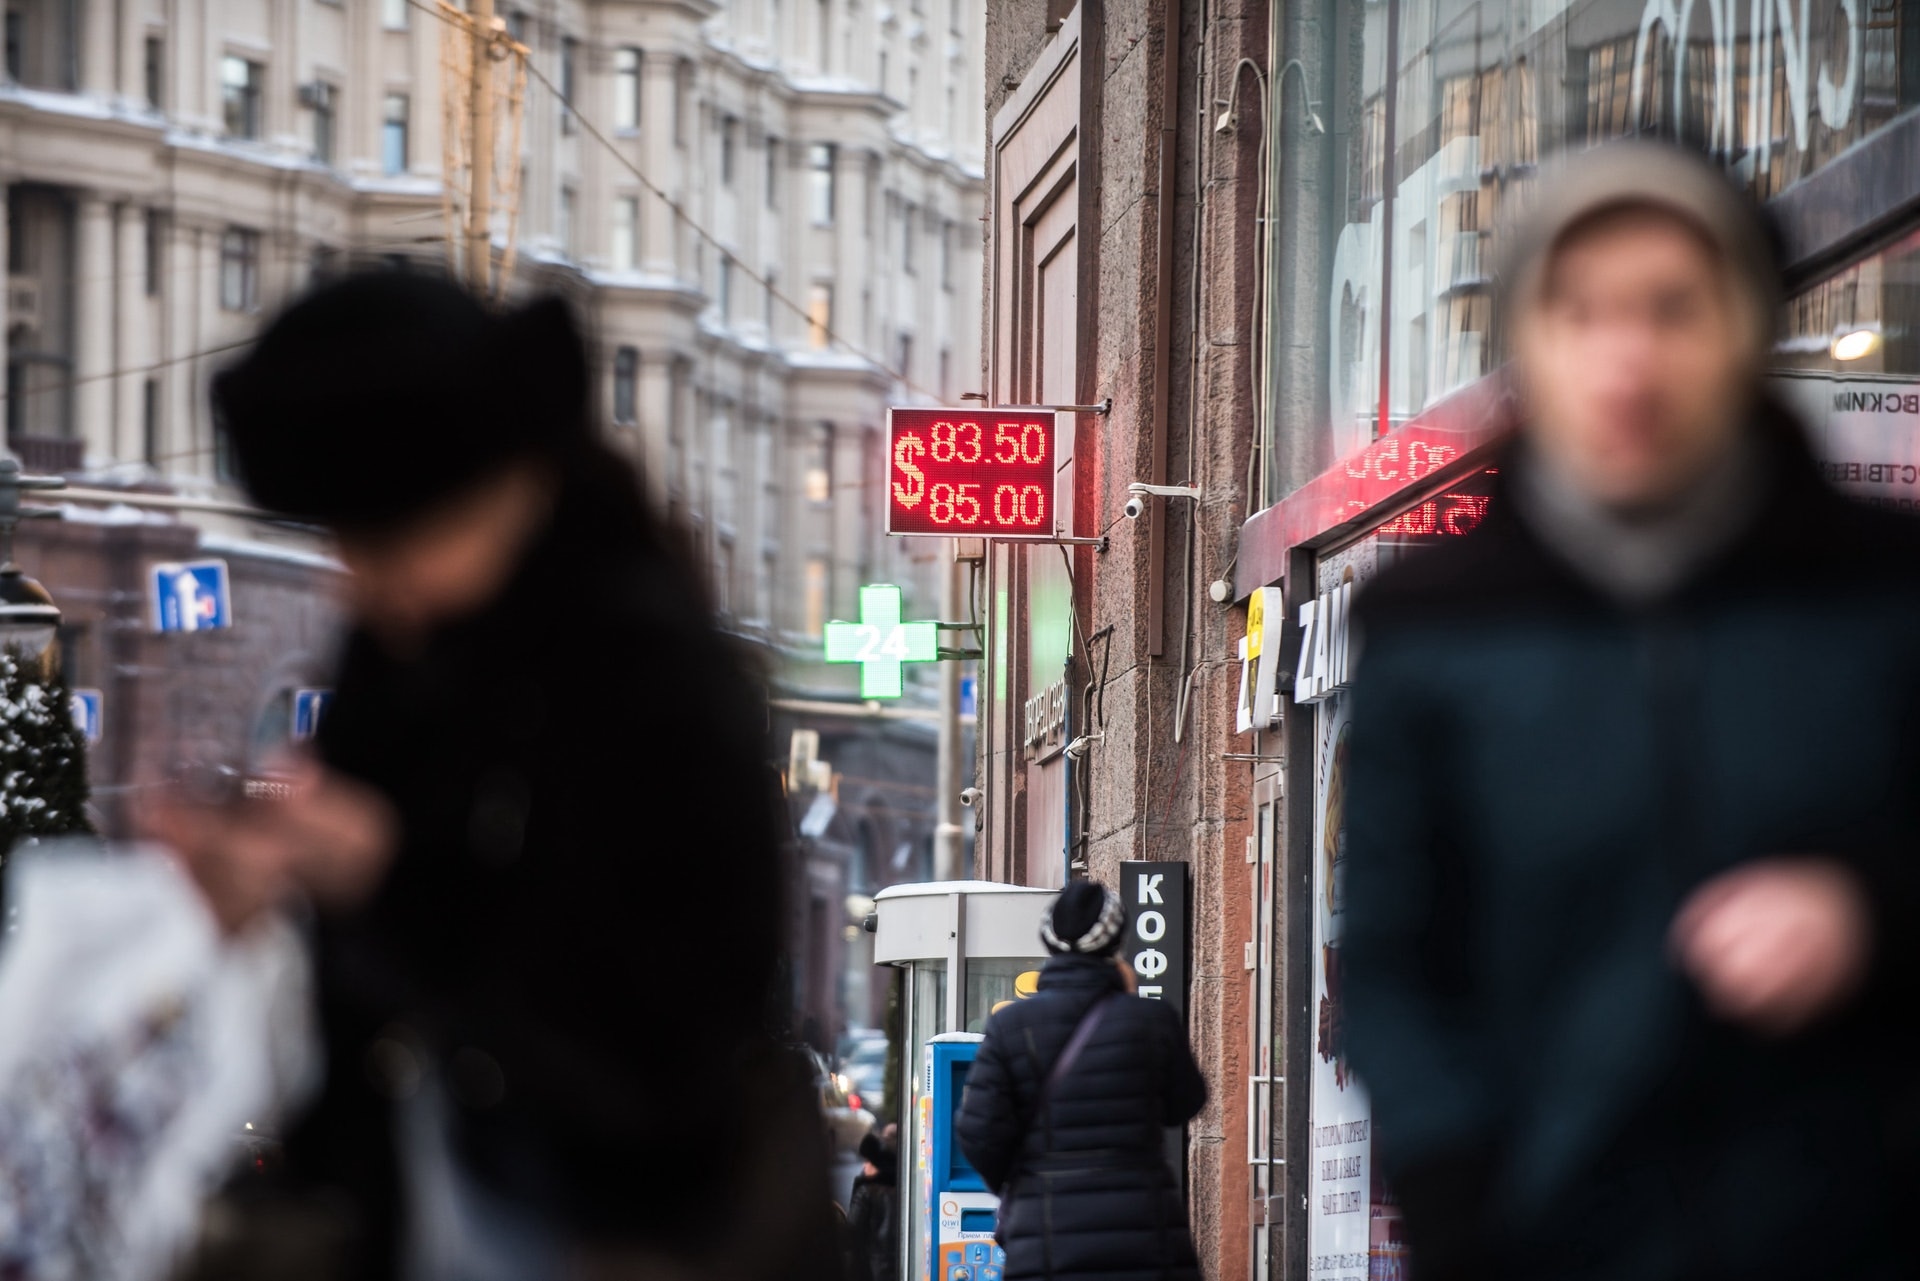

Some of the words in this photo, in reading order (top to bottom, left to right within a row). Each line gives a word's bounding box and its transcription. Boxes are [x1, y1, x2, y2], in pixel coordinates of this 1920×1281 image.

[931, 422, 1045, 464] 83.50
[892, 431, 925, 509] $
[929, 483, 1044, 525] 85.00
[855, 624, 910, 660] 24
